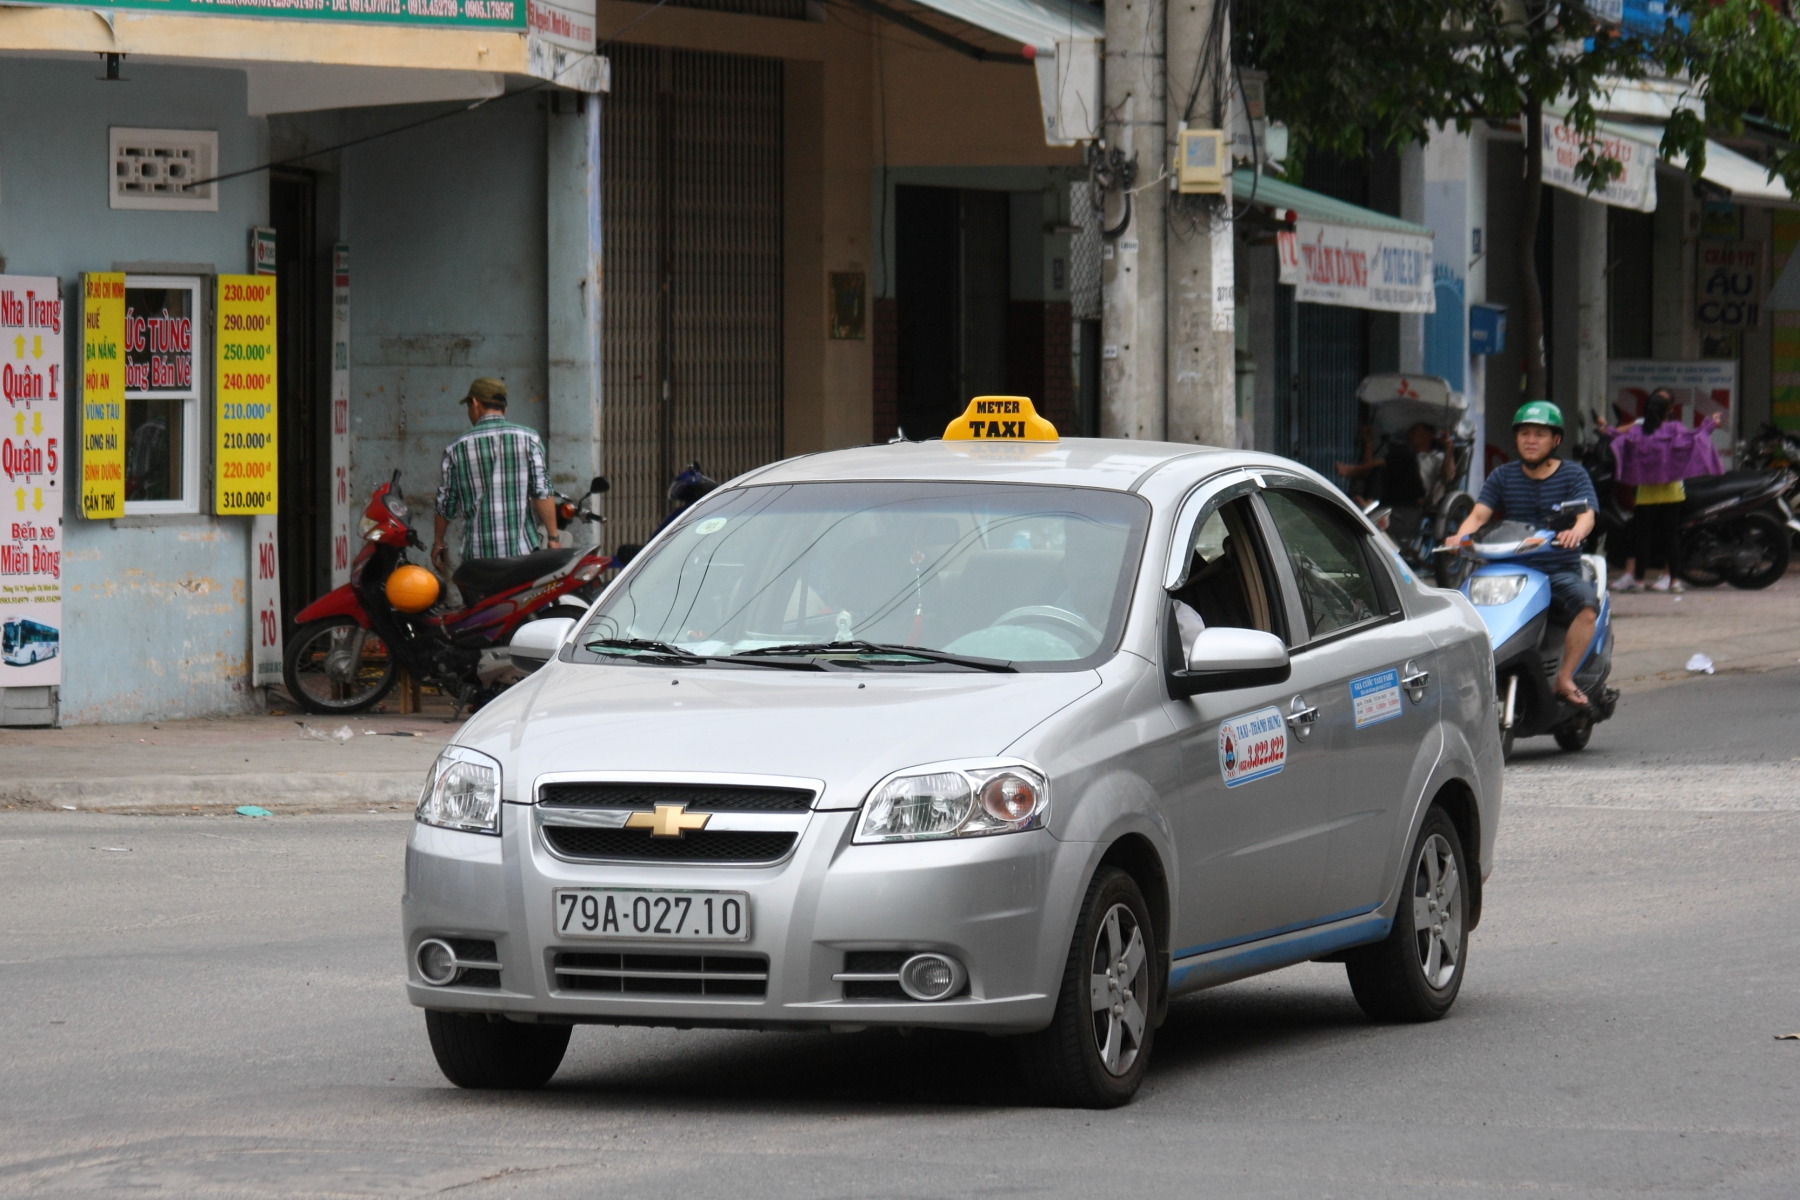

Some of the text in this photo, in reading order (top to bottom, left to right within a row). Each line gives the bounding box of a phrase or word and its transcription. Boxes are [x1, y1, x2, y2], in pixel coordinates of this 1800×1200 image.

[408, 0, 458, 17] 0913.452799
[465, 0, 514, 20] 0905.179587
[1, 290, 61, 334] Nha Trang
[86, 306, 101, 329] HUẾ
[125, 307, 192, 353] ÚC TÙNG
[2, 363, 58, 409] Quận 1
[86, 369, 110, 394] HỘI AN
[152, 355, 175, 387] Bán
[176, 355, 192, 387] Vé
[976, 401, 1020, 414] METER
[85, 433, 104, 451] LONG
[968, 420, 1026, 438] TAXI
[2, 437, 58, 485] Quận 5
[11, 521, 55, 541] Bến xe
[1, 541, 61, 580] Miền Đông
[259, 531, 275, 580] MÔ
[260, 598, 276, 648] TÔ
[1236, 722, 1249, 740] TAXI
[560, 894, 741, 936] 79A-027.10
